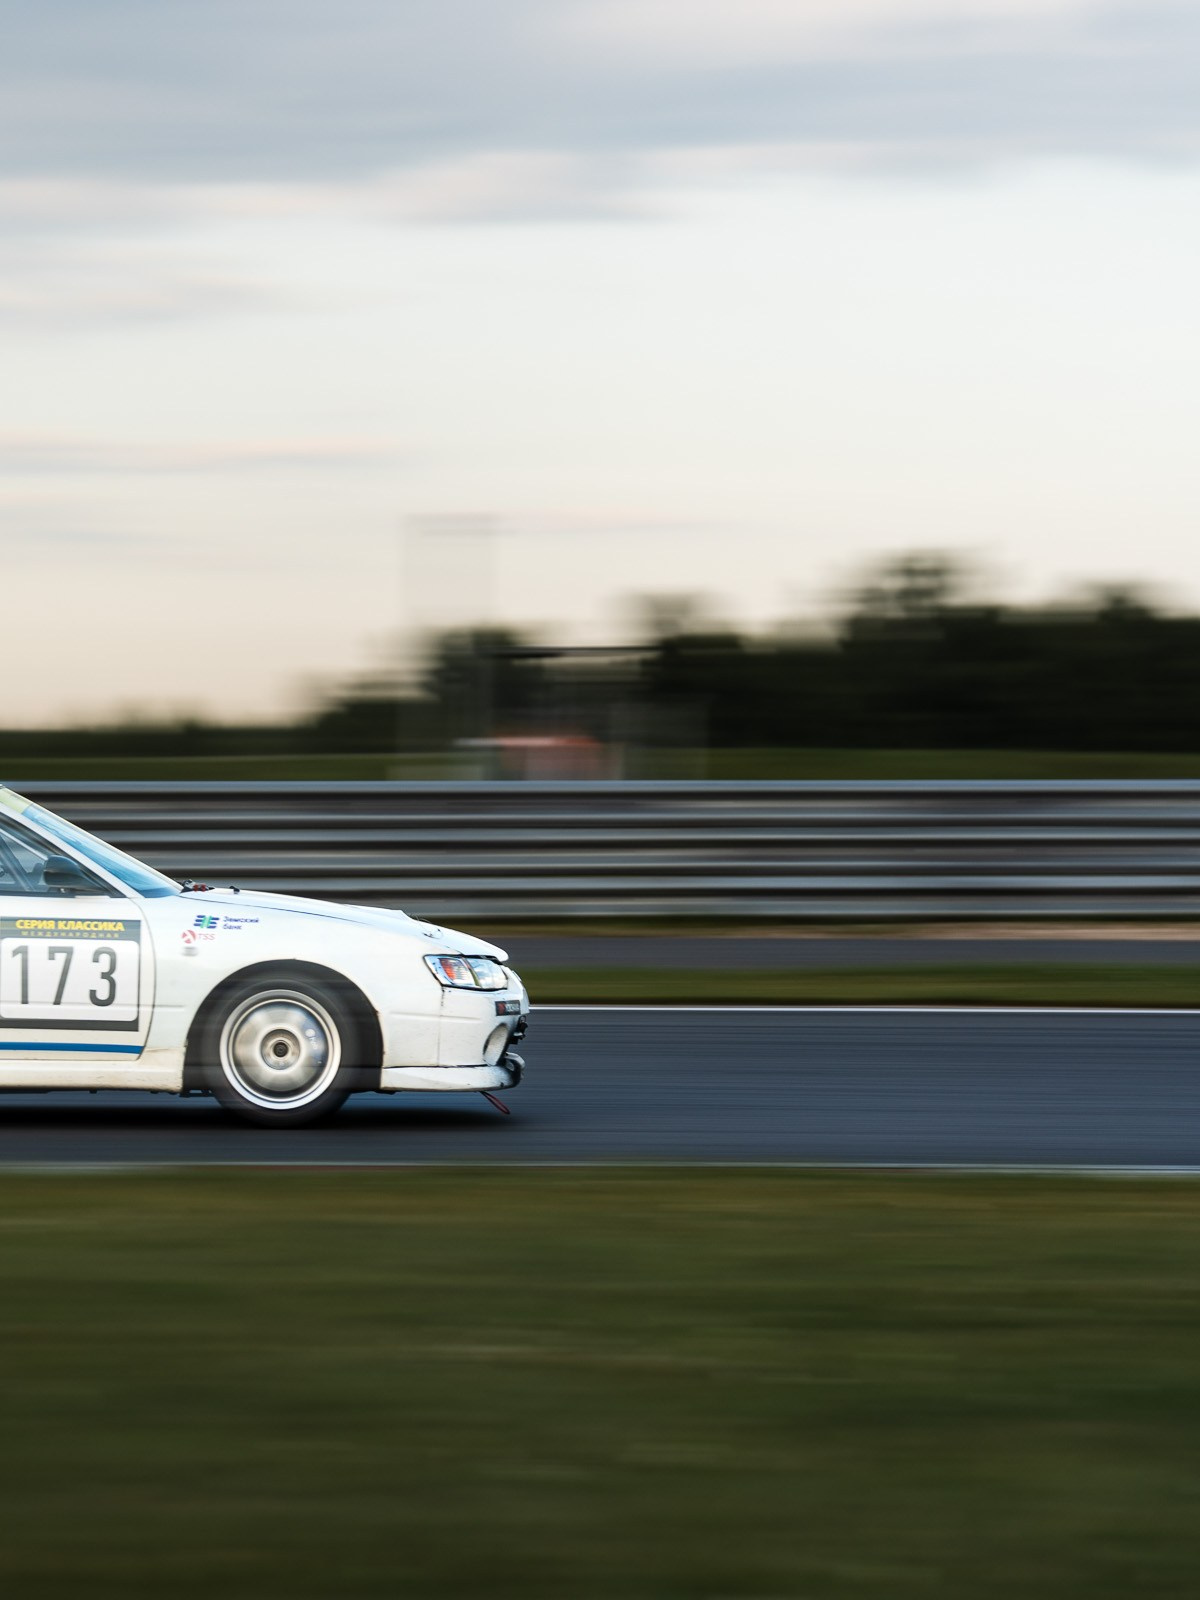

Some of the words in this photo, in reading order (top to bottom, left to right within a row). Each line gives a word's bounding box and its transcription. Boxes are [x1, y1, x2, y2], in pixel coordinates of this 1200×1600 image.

[15, 919, 56, 930] СЕРИЯ
[57, 920, 125, 932] КЛАССИКА
[11, 944, 117, 1008] 173
